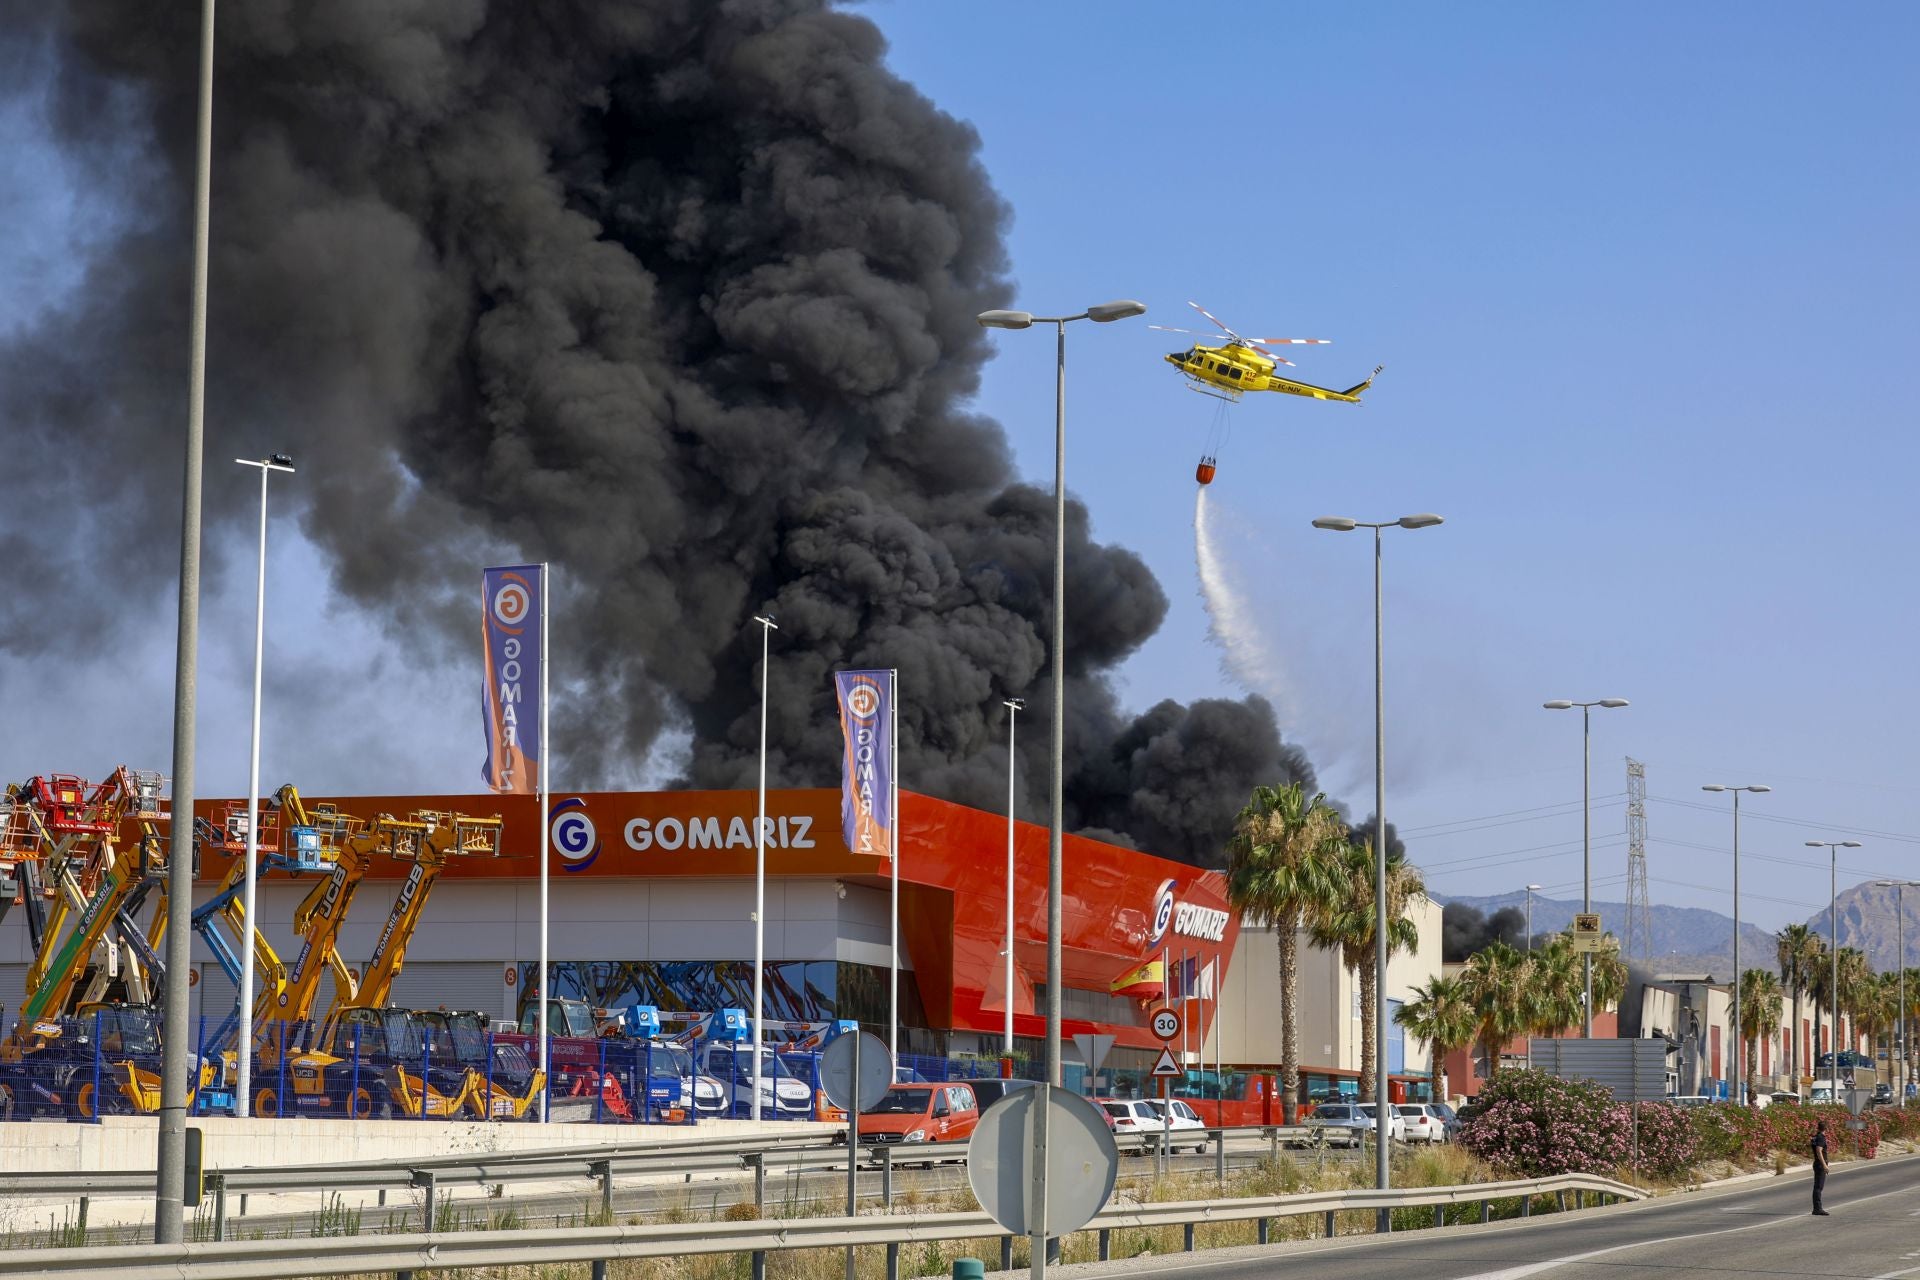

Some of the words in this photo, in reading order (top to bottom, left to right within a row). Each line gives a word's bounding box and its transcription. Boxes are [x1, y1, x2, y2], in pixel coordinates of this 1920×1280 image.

[624, 816, 816, 851] GOMARIZ
[84, 884, 111, 925] GOMARIZ
[323, 867, 347, 918] JCB
[401, 864, 424, 913] JCB
[376, 912, 400, 956] GOMARIZ
[1174, 902, 1230, 942] GOMARIZ
[296, 943, 311, 975] GOMARIZ
[1157, 1019, 1176, 1030] 30
[296, 1068, 314, 1078] JCB
